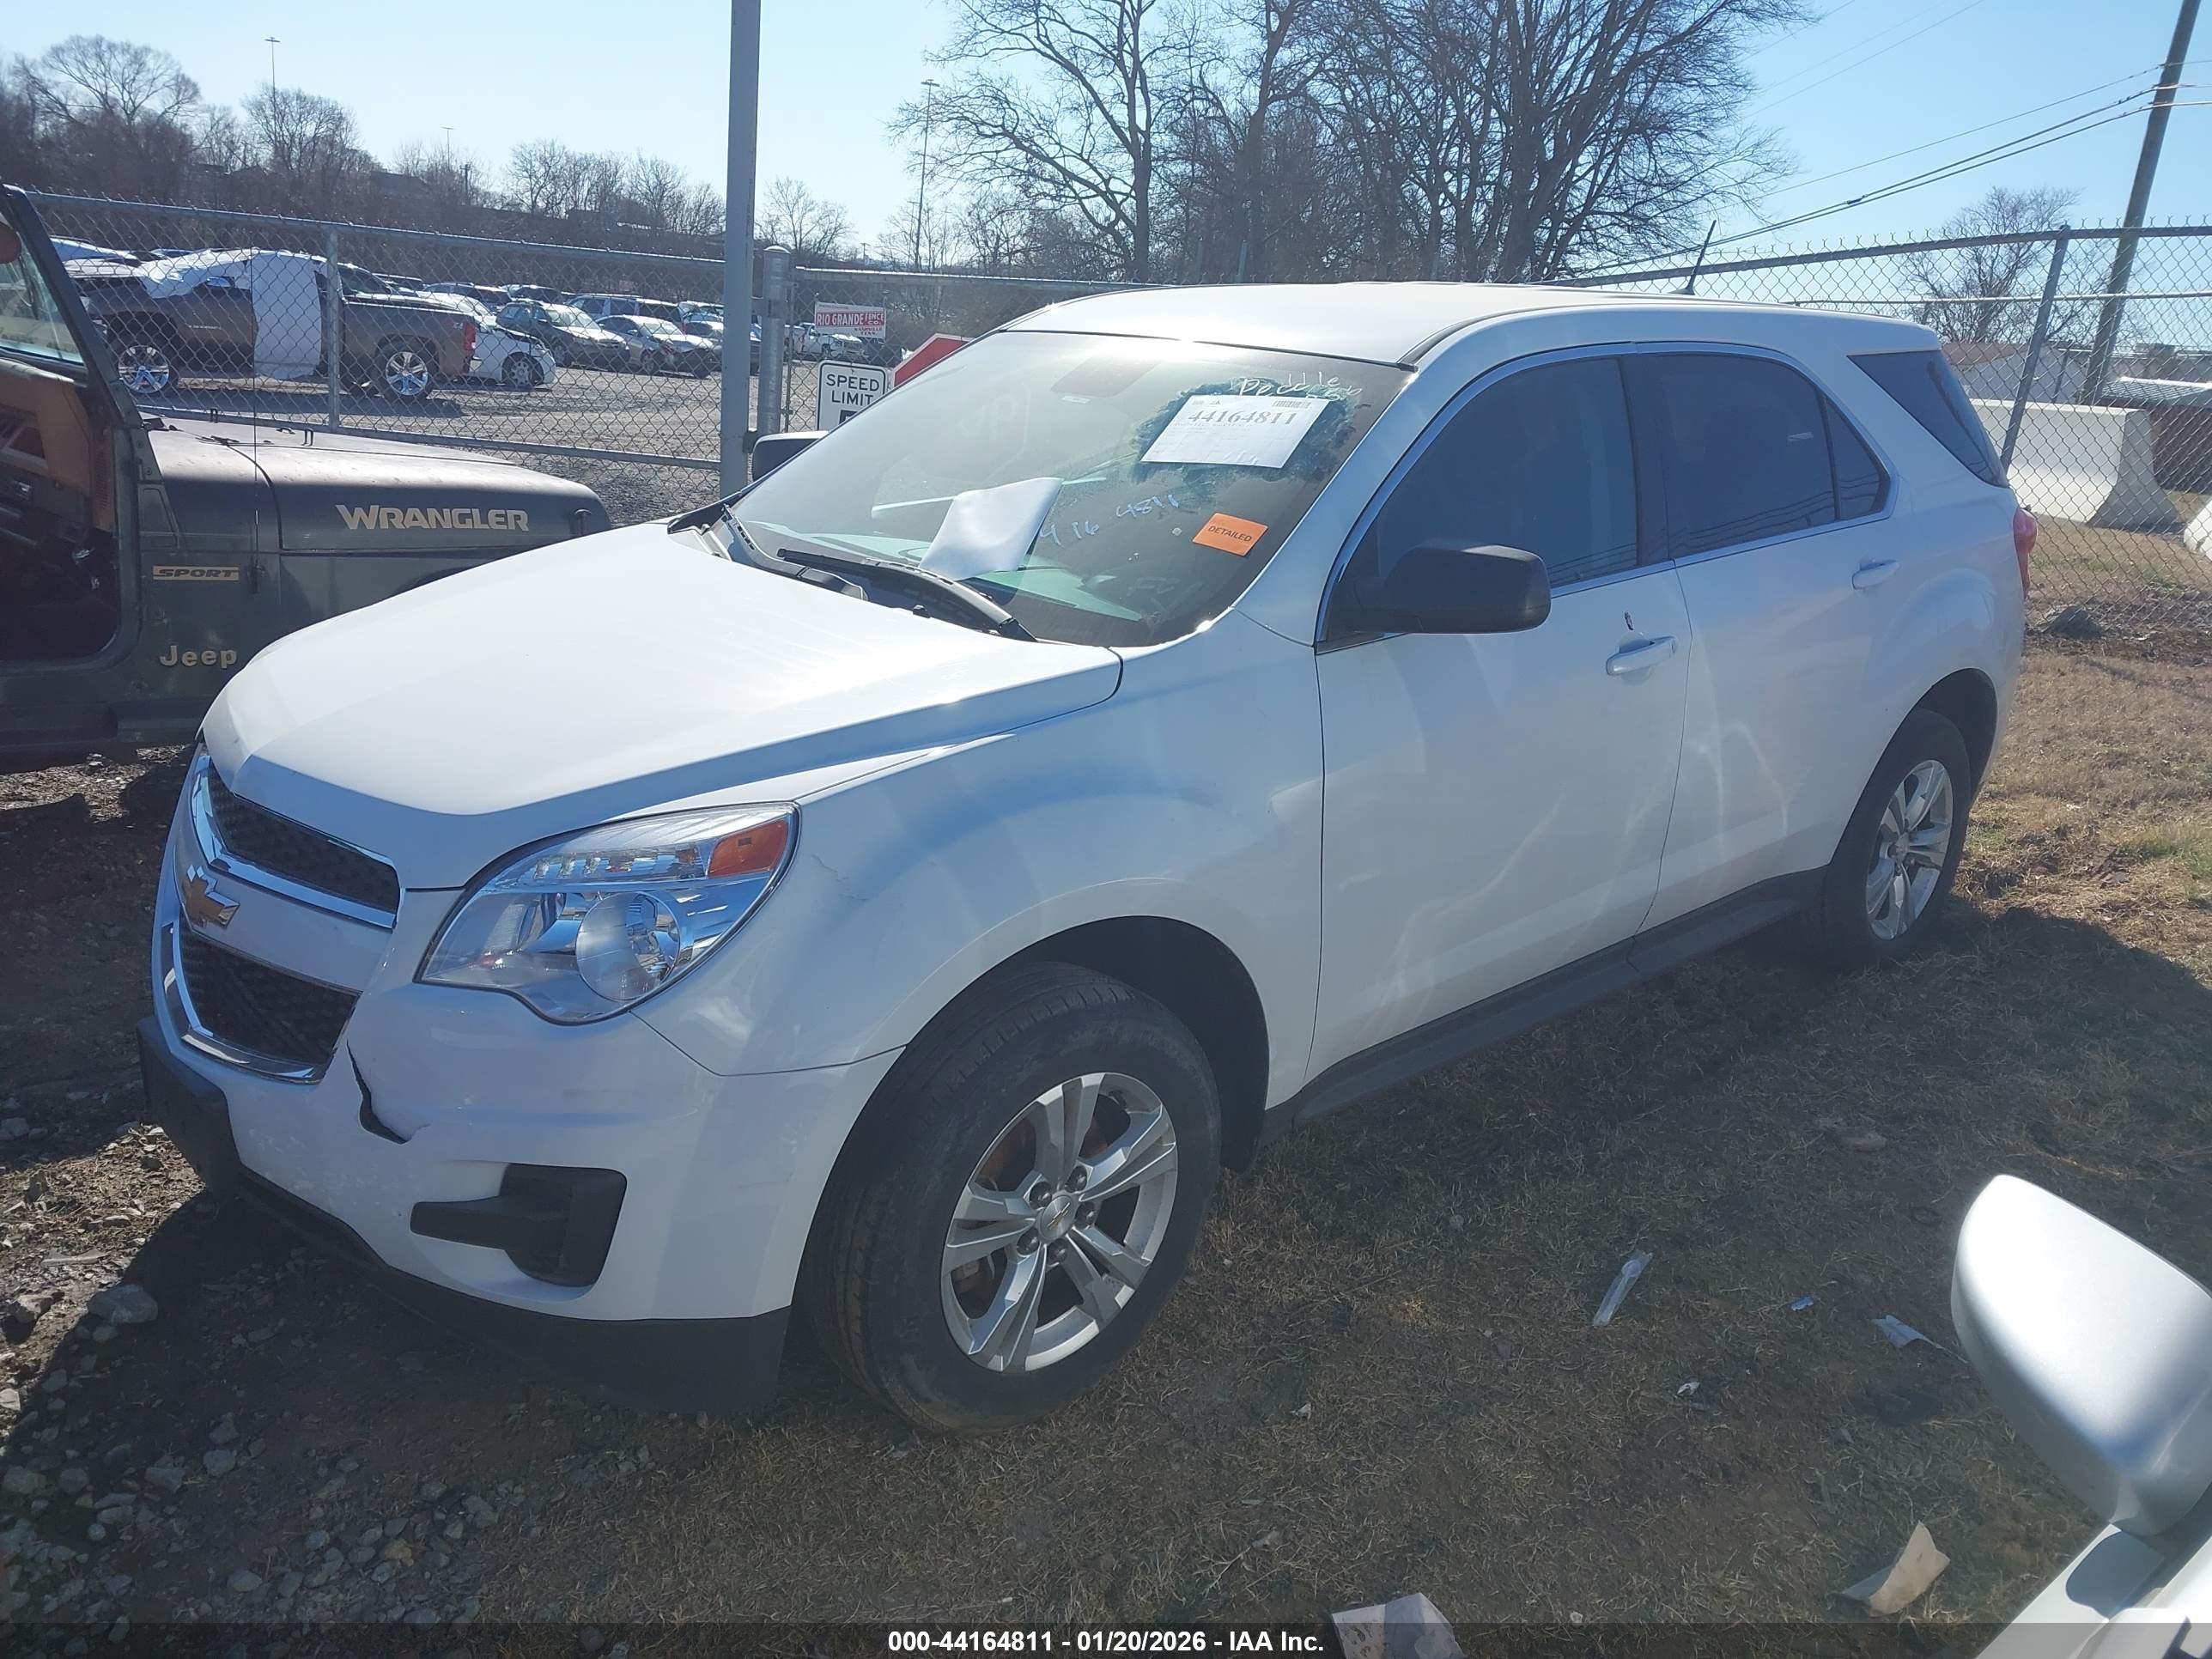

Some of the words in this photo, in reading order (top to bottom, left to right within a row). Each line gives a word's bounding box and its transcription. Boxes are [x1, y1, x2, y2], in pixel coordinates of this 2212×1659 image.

[817, 313, 830, 325] RIO
[831, 313, 864, 326] GRANDE
[826, 374, 879, 392] SPEED
[831, 390, 873, 406] LIMIT
[1188, 410, 1297, 425] 44164811
[335, 504, 530, 532] WRANGLER
[1208, 526, 1252, 542] DETAILED
[158, 568, 239, 578] SPORT
[159, 646, 238, 668] Jeep
